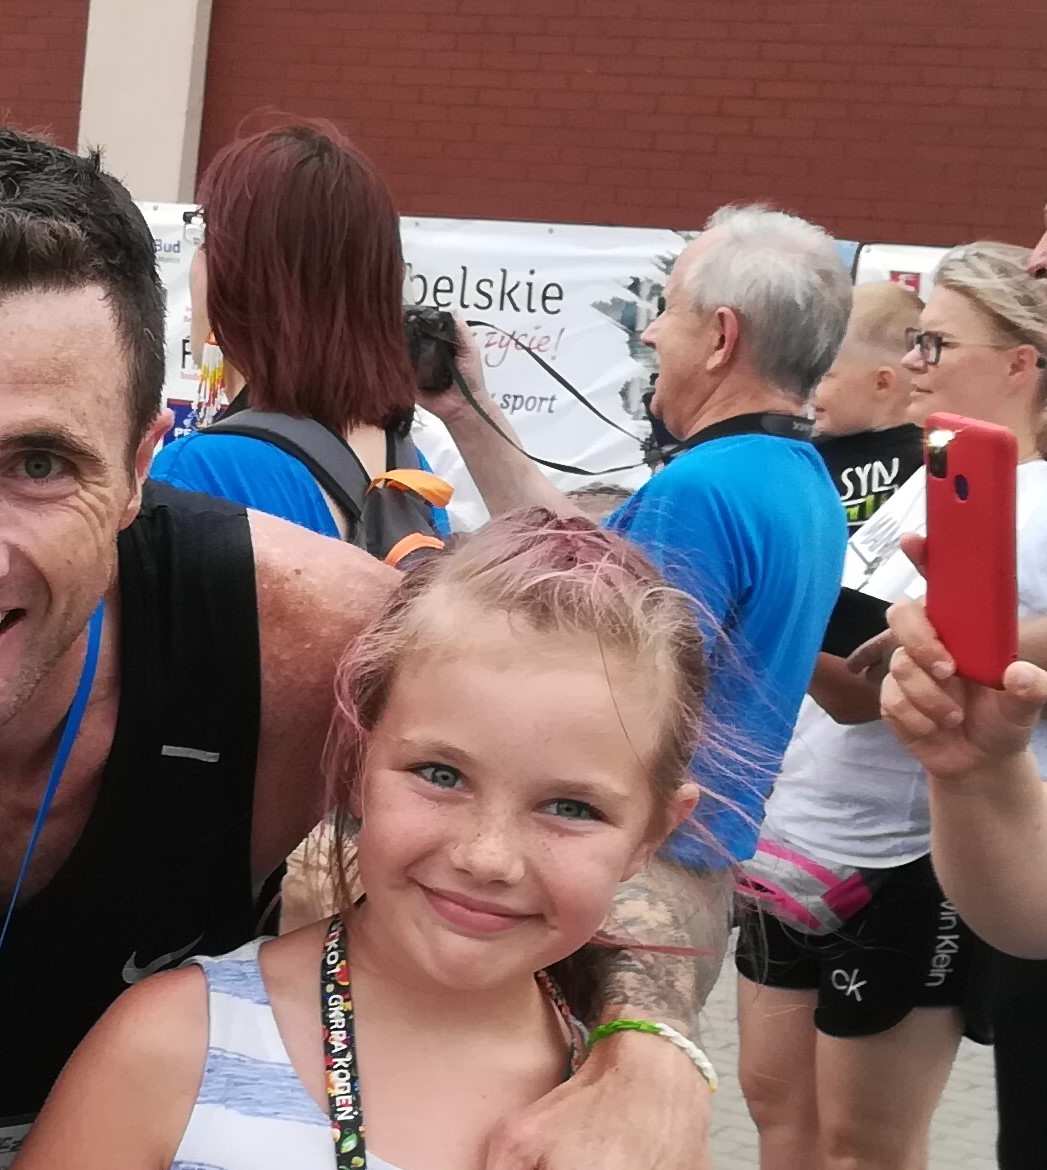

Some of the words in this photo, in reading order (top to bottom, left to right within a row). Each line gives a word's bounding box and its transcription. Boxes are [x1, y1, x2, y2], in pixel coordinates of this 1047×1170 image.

[404, 262, 564, 315] belskie
[500, 393, 557, 415] sport
[924, 934, 961, 988] Klein
